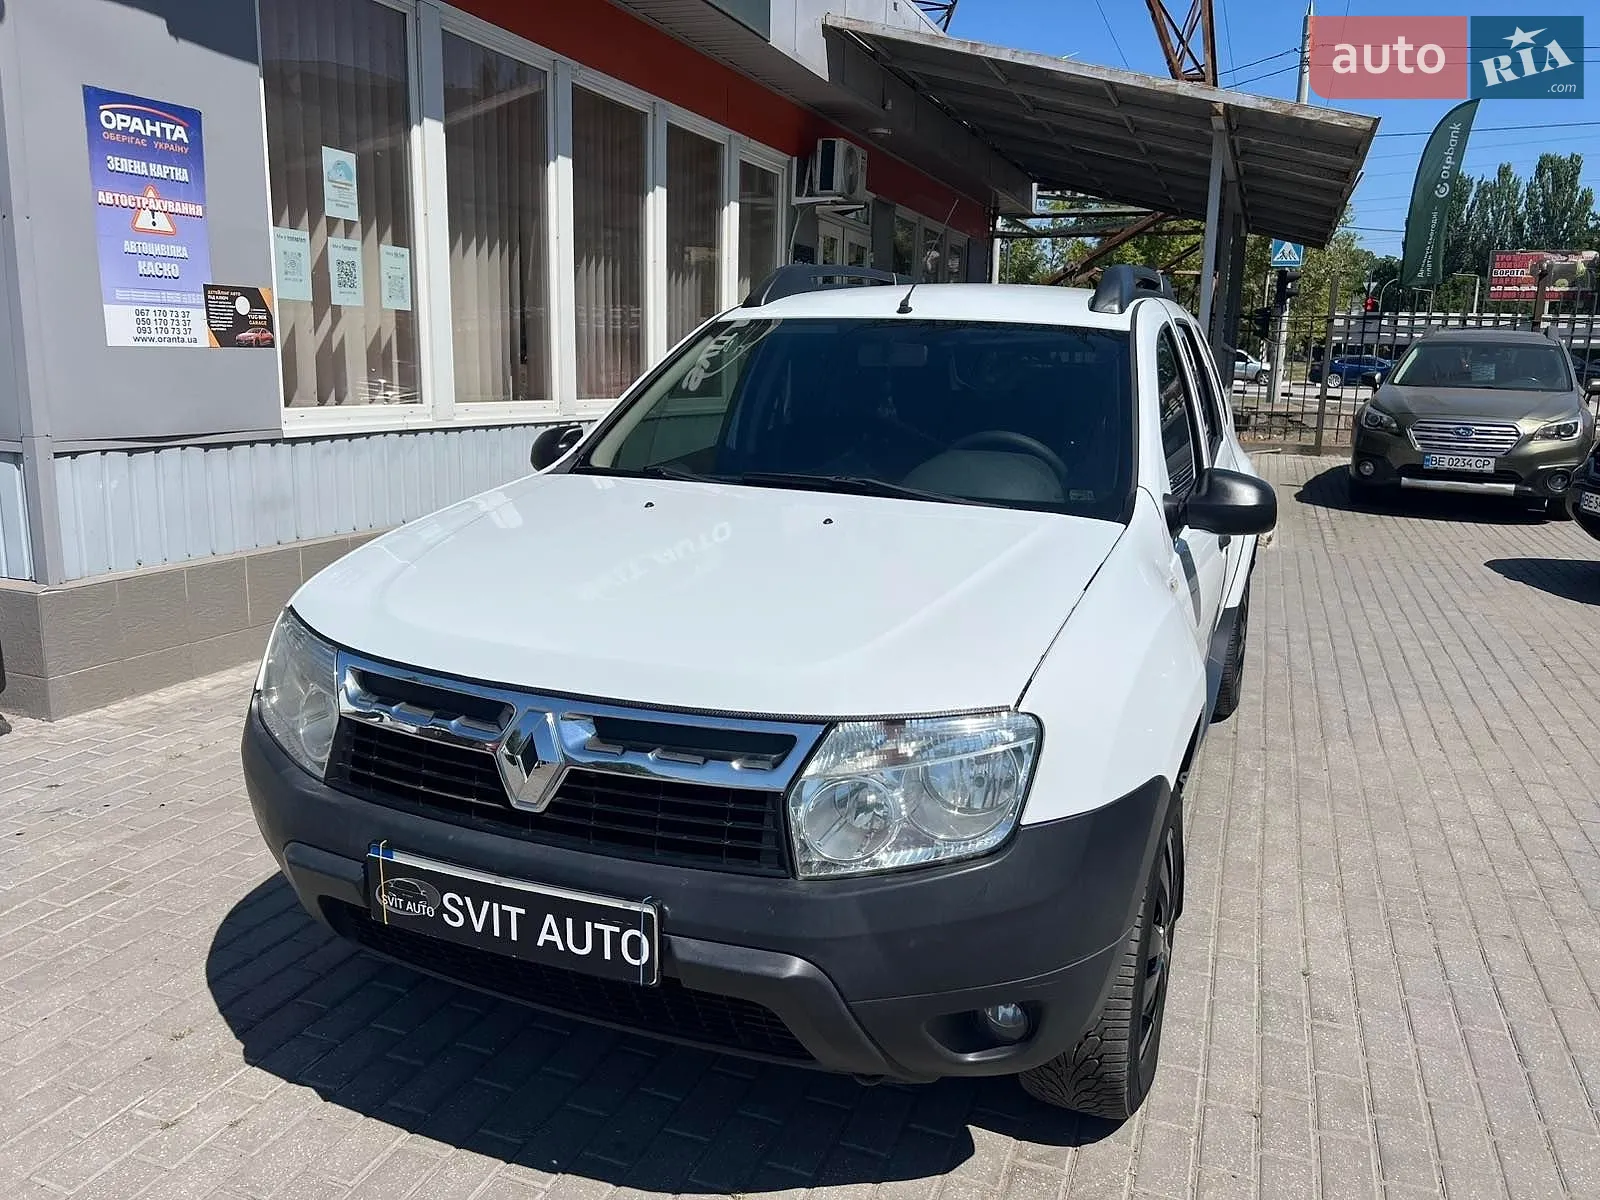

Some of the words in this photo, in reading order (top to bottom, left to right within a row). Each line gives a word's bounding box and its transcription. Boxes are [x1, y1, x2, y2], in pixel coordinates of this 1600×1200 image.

[100, 110, 189, 143] ОРАНТА
[102, 132, 147, 147] ОБЕРІГАЄ
[153, 140, 189, 154] УКРАЇНУ
[1441, 123, 1462, 179] otpbank
[106, 155, 148, 176] ЗЕЛЕНА
[149, 162, 189, 183] КАРТКА
[98, 191, 203, 217] АВТОСТРАХУВАННЯ
[123, 240, 188, 259] АВТОЦИВІЛКА
[138, 261, 180, 279] КАСКО
[135, 309, 150, 317] 067
[153, 310, 167, 318] 170
[169, 310, 179, 318] 73
[181, 311, 190, 319] 37
[135, 318, 151, 326] 050
[170, 319, 180, 327] 73
[182, 319, 191, 327] 37
[132, 336, 198, 344] www.oranta.ua
[136, 326, 152, 334] 093
[154, 327, 169, 335] 170
[171, 327, 181, 335] 73
[1431, 456, 1446, 466] BE
[1448, 457, 1473, 468] 0234
[1475, 459, 1491, 469] CP
[382, 894, 404, 909] SVIT
[406, 901, 435, 917] AUTO
[442, 893, 526, 941] SVIT
[536, 914, 650, 966] AUTO
